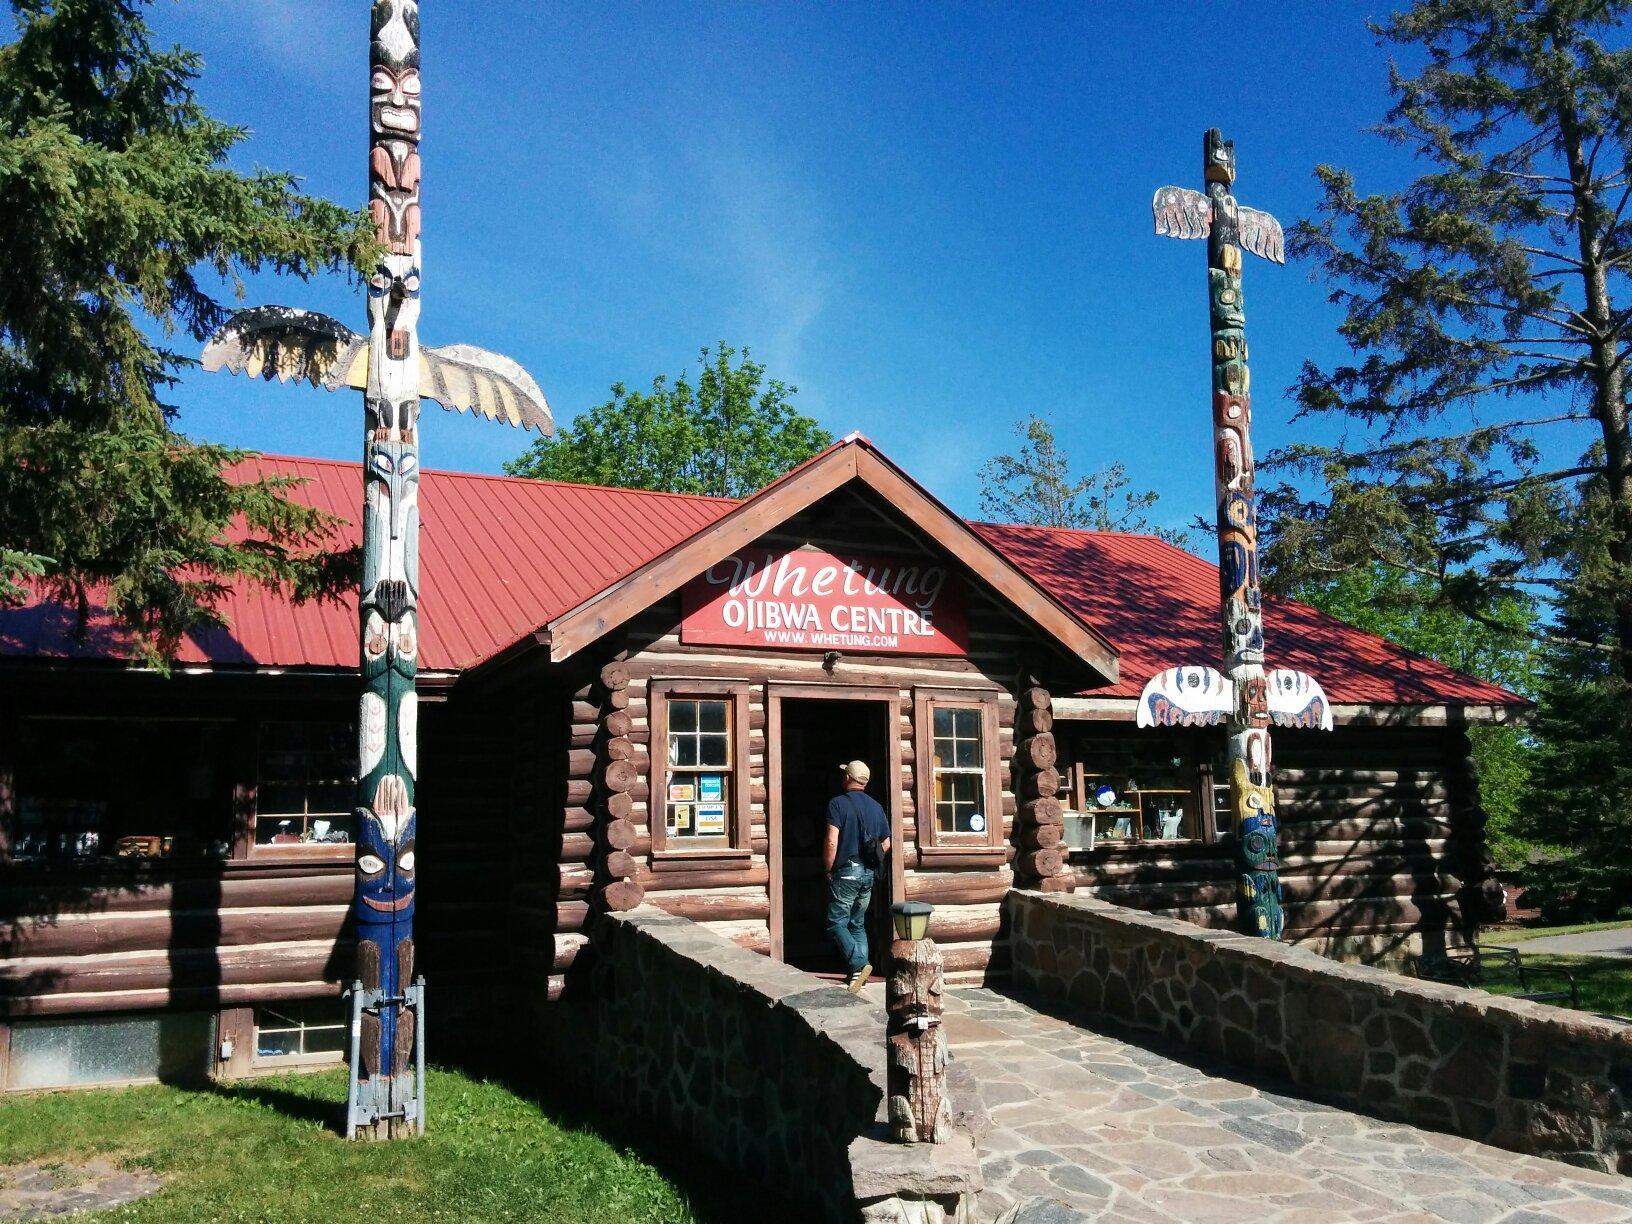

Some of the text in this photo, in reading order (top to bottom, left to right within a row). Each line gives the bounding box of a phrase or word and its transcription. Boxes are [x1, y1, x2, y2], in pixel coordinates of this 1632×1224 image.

[706, 554, 946, 607] Whetung
[722, 599, 935, 636] OJIBWA CENTRE
[810, 632, 898, 647] WHETUNG.COM
